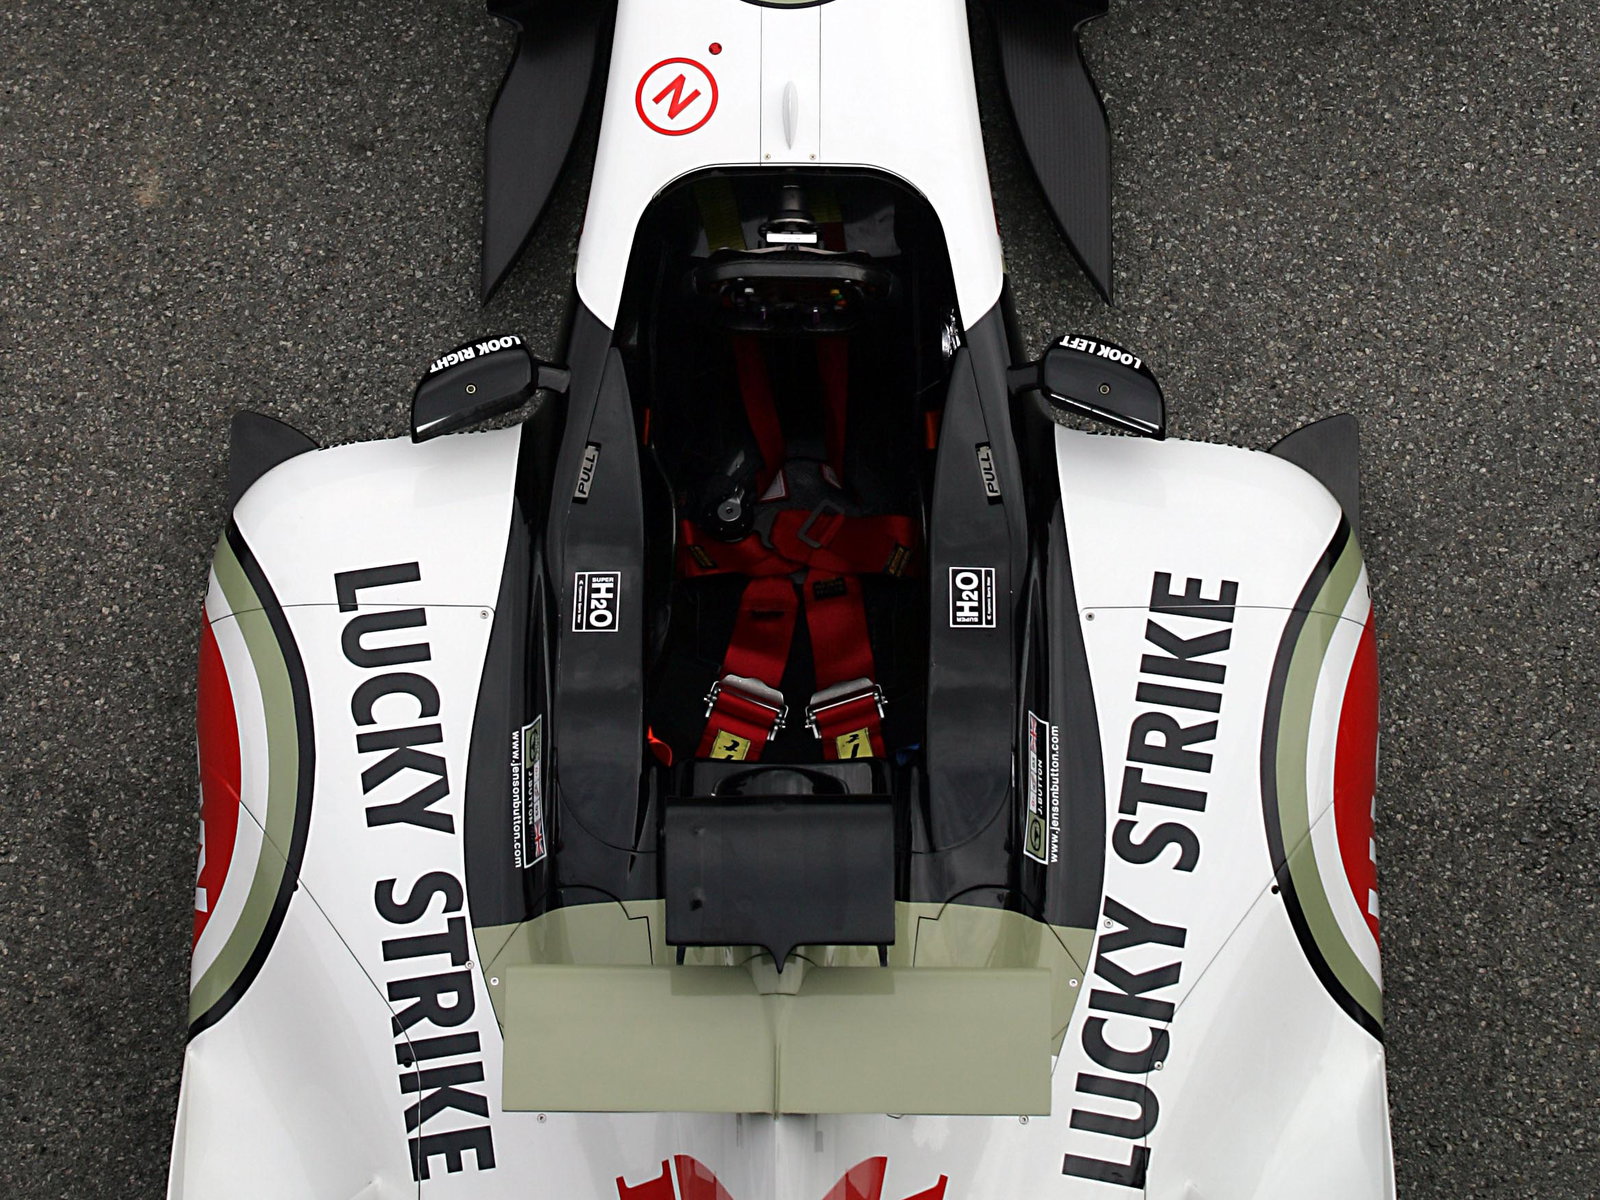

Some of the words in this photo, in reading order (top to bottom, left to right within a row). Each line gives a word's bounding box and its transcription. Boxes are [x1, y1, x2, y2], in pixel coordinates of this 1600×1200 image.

[429, 346, 476, 373] RIGHT
[475, 335, 521, 356] LOOK
[1059, 335, 1097, 354] LEFT
[1096, 344, 1142, 369] LOOK
[577, 454, 596, 496] PULL
[980, 452, 999, 494] PULL
[590, 582, 614, 628] H2O
[955, 571, 979, 617] H2O
[334, 561, 456, 835] LUCKY
[1112, 571, 1239, 873] STRIKE
[510, 730, 522, 868] www.jensonbutton.com
[1050, 725, 1061, 863] www.jensonbutton.com
[374, 871, 496, 1183] STRIKE
[1062, 894, 1187, 1190] LUCKY
